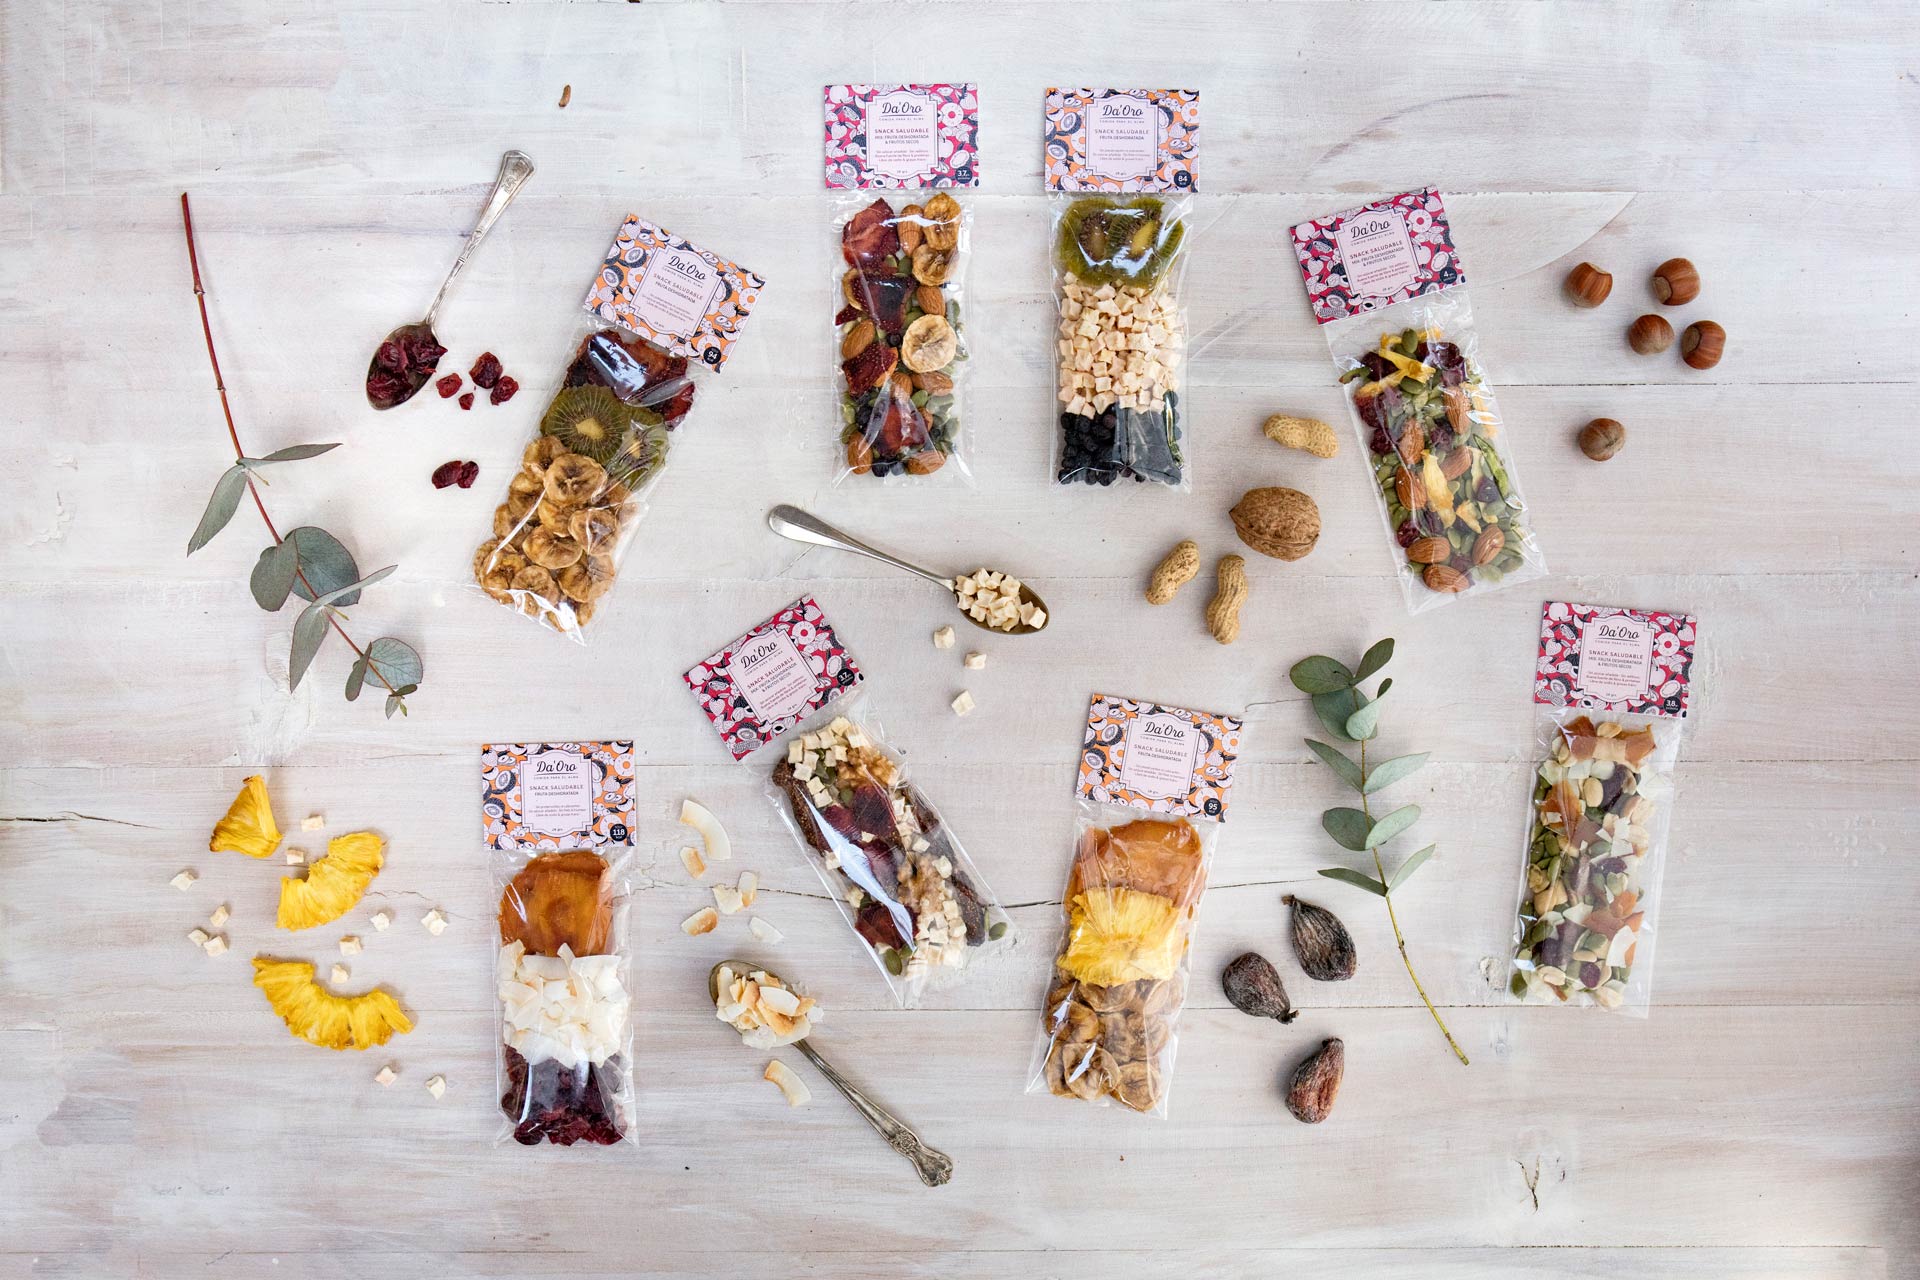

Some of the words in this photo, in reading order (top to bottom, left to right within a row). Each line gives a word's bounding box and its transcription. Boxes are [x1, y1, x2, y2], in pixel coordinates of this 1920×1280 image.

[882, 102, 923, 114] Da'Oro
[1103, 104, 1144, 116] Da'Oro
[1350, 220, 1390, 238] Da'Oro
[1350, 250, 1369, 259] SNACK
[1370, 240, 1403, 253] SALUDABLE
[668, 255, 706, 280] Da'Oro
[653, 273, 672, 285] SNACK
[672, 282, 703, 300] SALUDABLE
[655, 281, 668, 290] FRUTA
[709, 350, 718, 359] 94
[1598, 624, 1640, 639] Da'Oro
[741, 641, 777, 668] Da'Oro
[747, 675, 765, 689] SNACK
[764, 656, 794, 678] SALUDABLE
[759, 679, 771, 688] FRUTA
[765, 679, 780, 690] FRUTOS
[779, 672, 792, 682] SECOS
[1144, 721, 1185, 738] Da'Oro
[1155, 748, 1187, 757] SALUDABLE
[536, 760, 577, 773] Da'Oro
